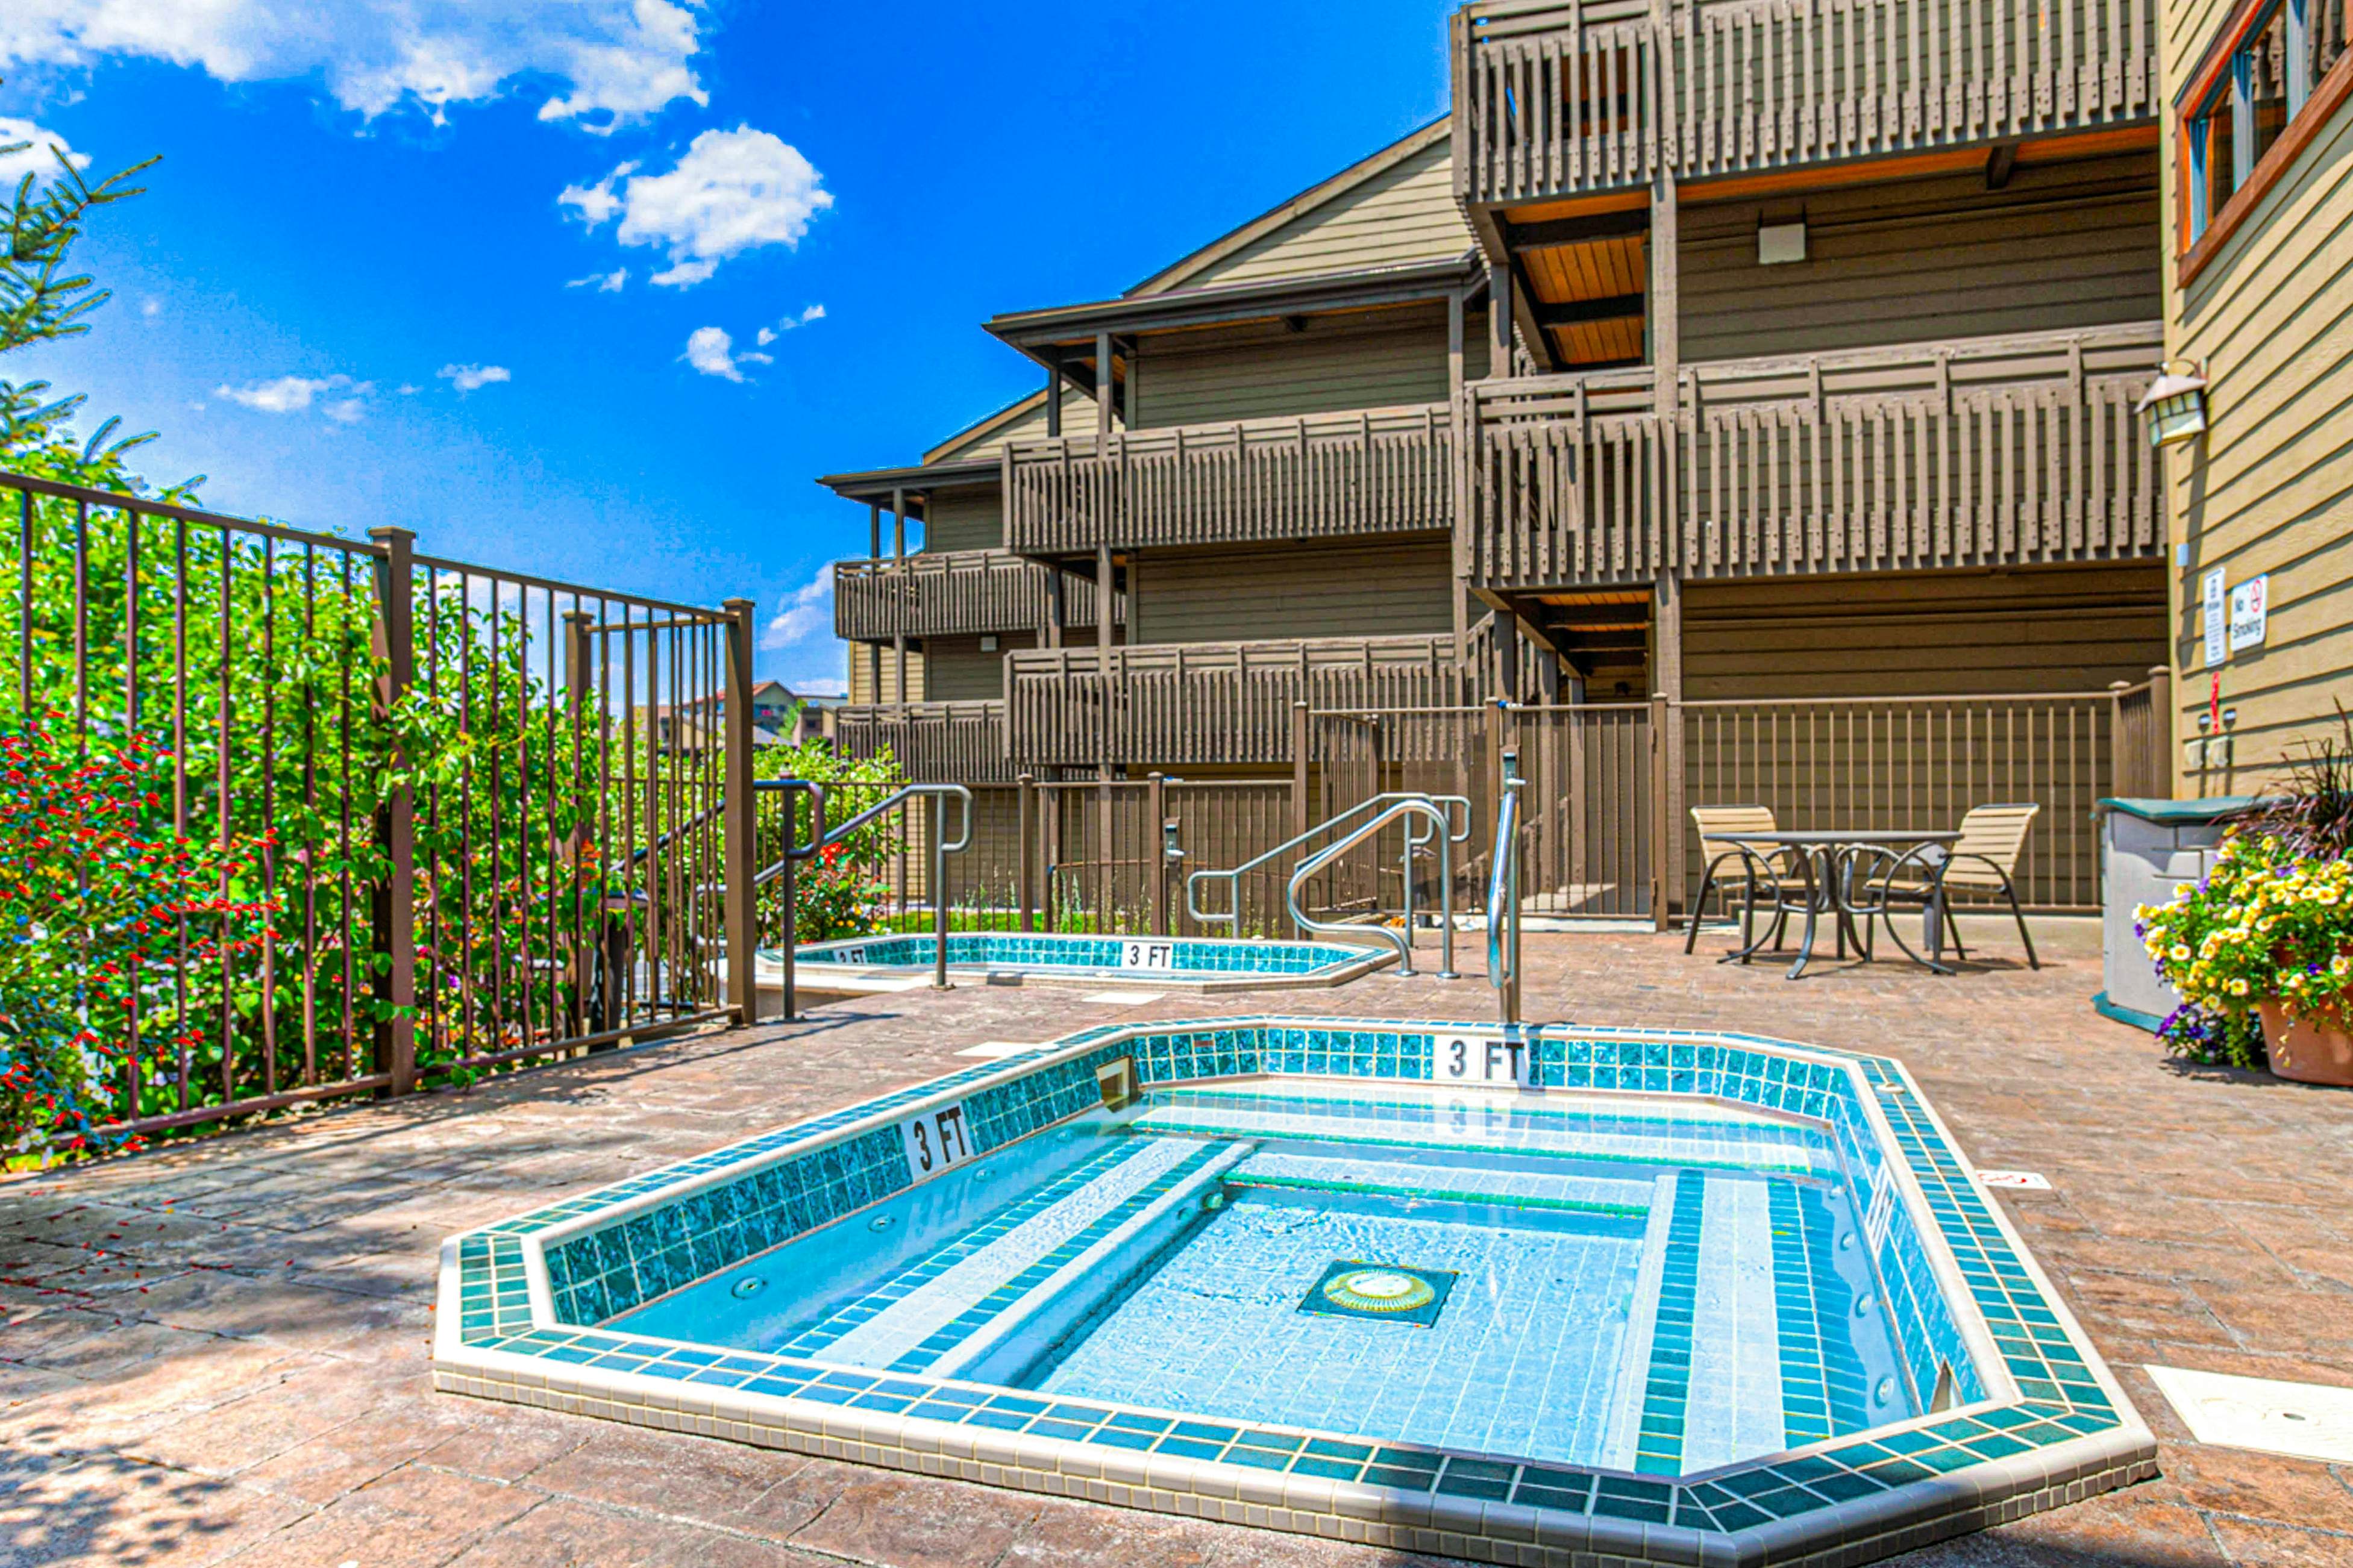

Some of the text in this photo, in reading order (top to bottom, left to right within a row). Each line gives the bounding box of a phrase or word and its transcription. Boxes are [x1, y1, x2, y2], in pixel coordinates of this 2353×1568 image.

[2233, 619, 2261, 639] Smoking
[851, 949, 863, 963] FT
[1130, 945, 1170, 967] 3 FT
[1449, 1040, 1524, 1079] 3 FT
[913, 1106, 966, 1171] 3 FT
